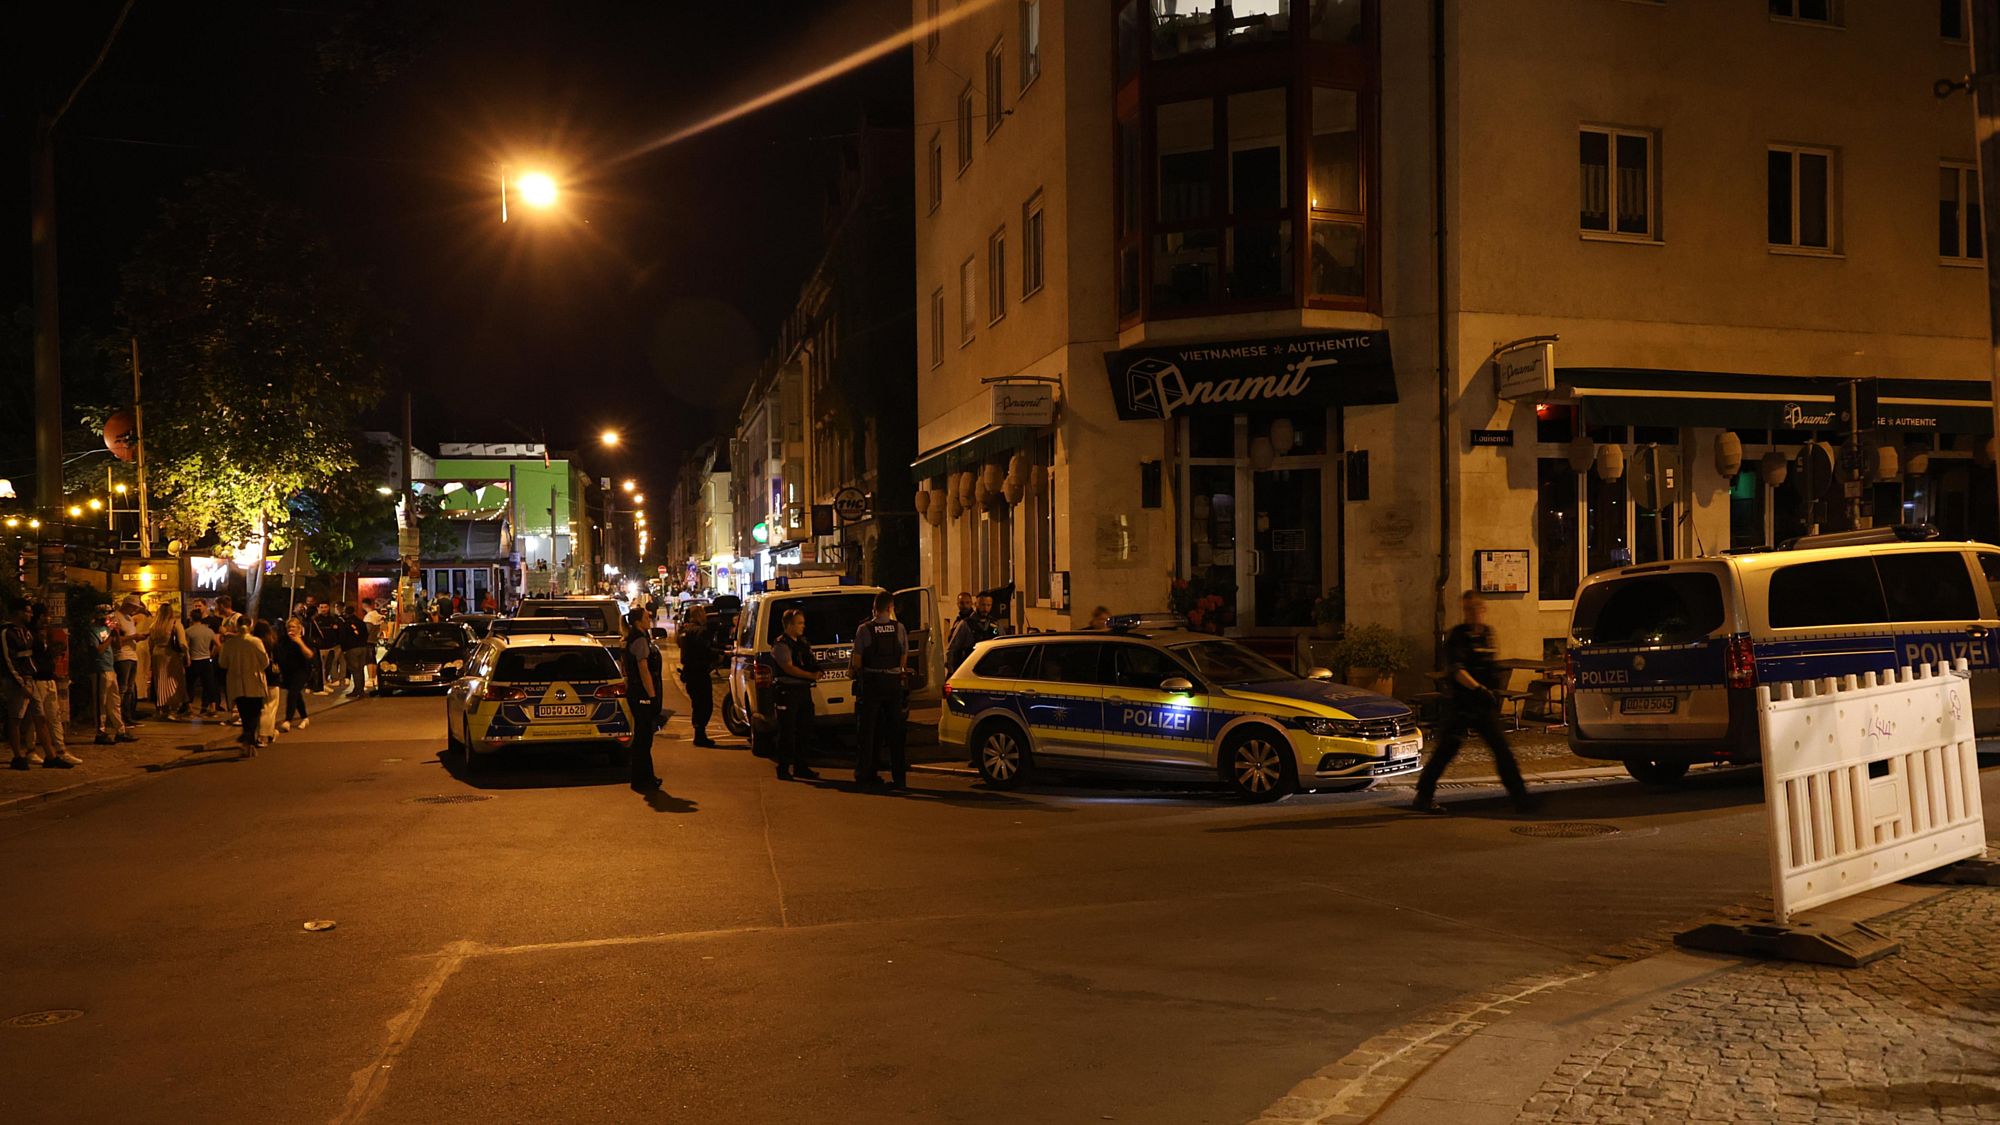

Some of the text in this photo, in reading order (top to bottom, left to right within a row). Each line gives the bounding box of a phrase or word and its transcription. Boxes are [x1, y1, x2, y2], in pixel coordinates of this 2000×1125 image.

[1180, 336, 1372, 361] VIETNAMESE AUTHENTIC
[1895, 417, 1937, 426] AUTHENTIC
[874, 624, 895, 634] POLIZEI
[1906, 641, 1990, 667] POLIZEI
[1582, 669, 1629, 685] POLIZEI
[1123, 707, 1191, 732] POLIZEI
